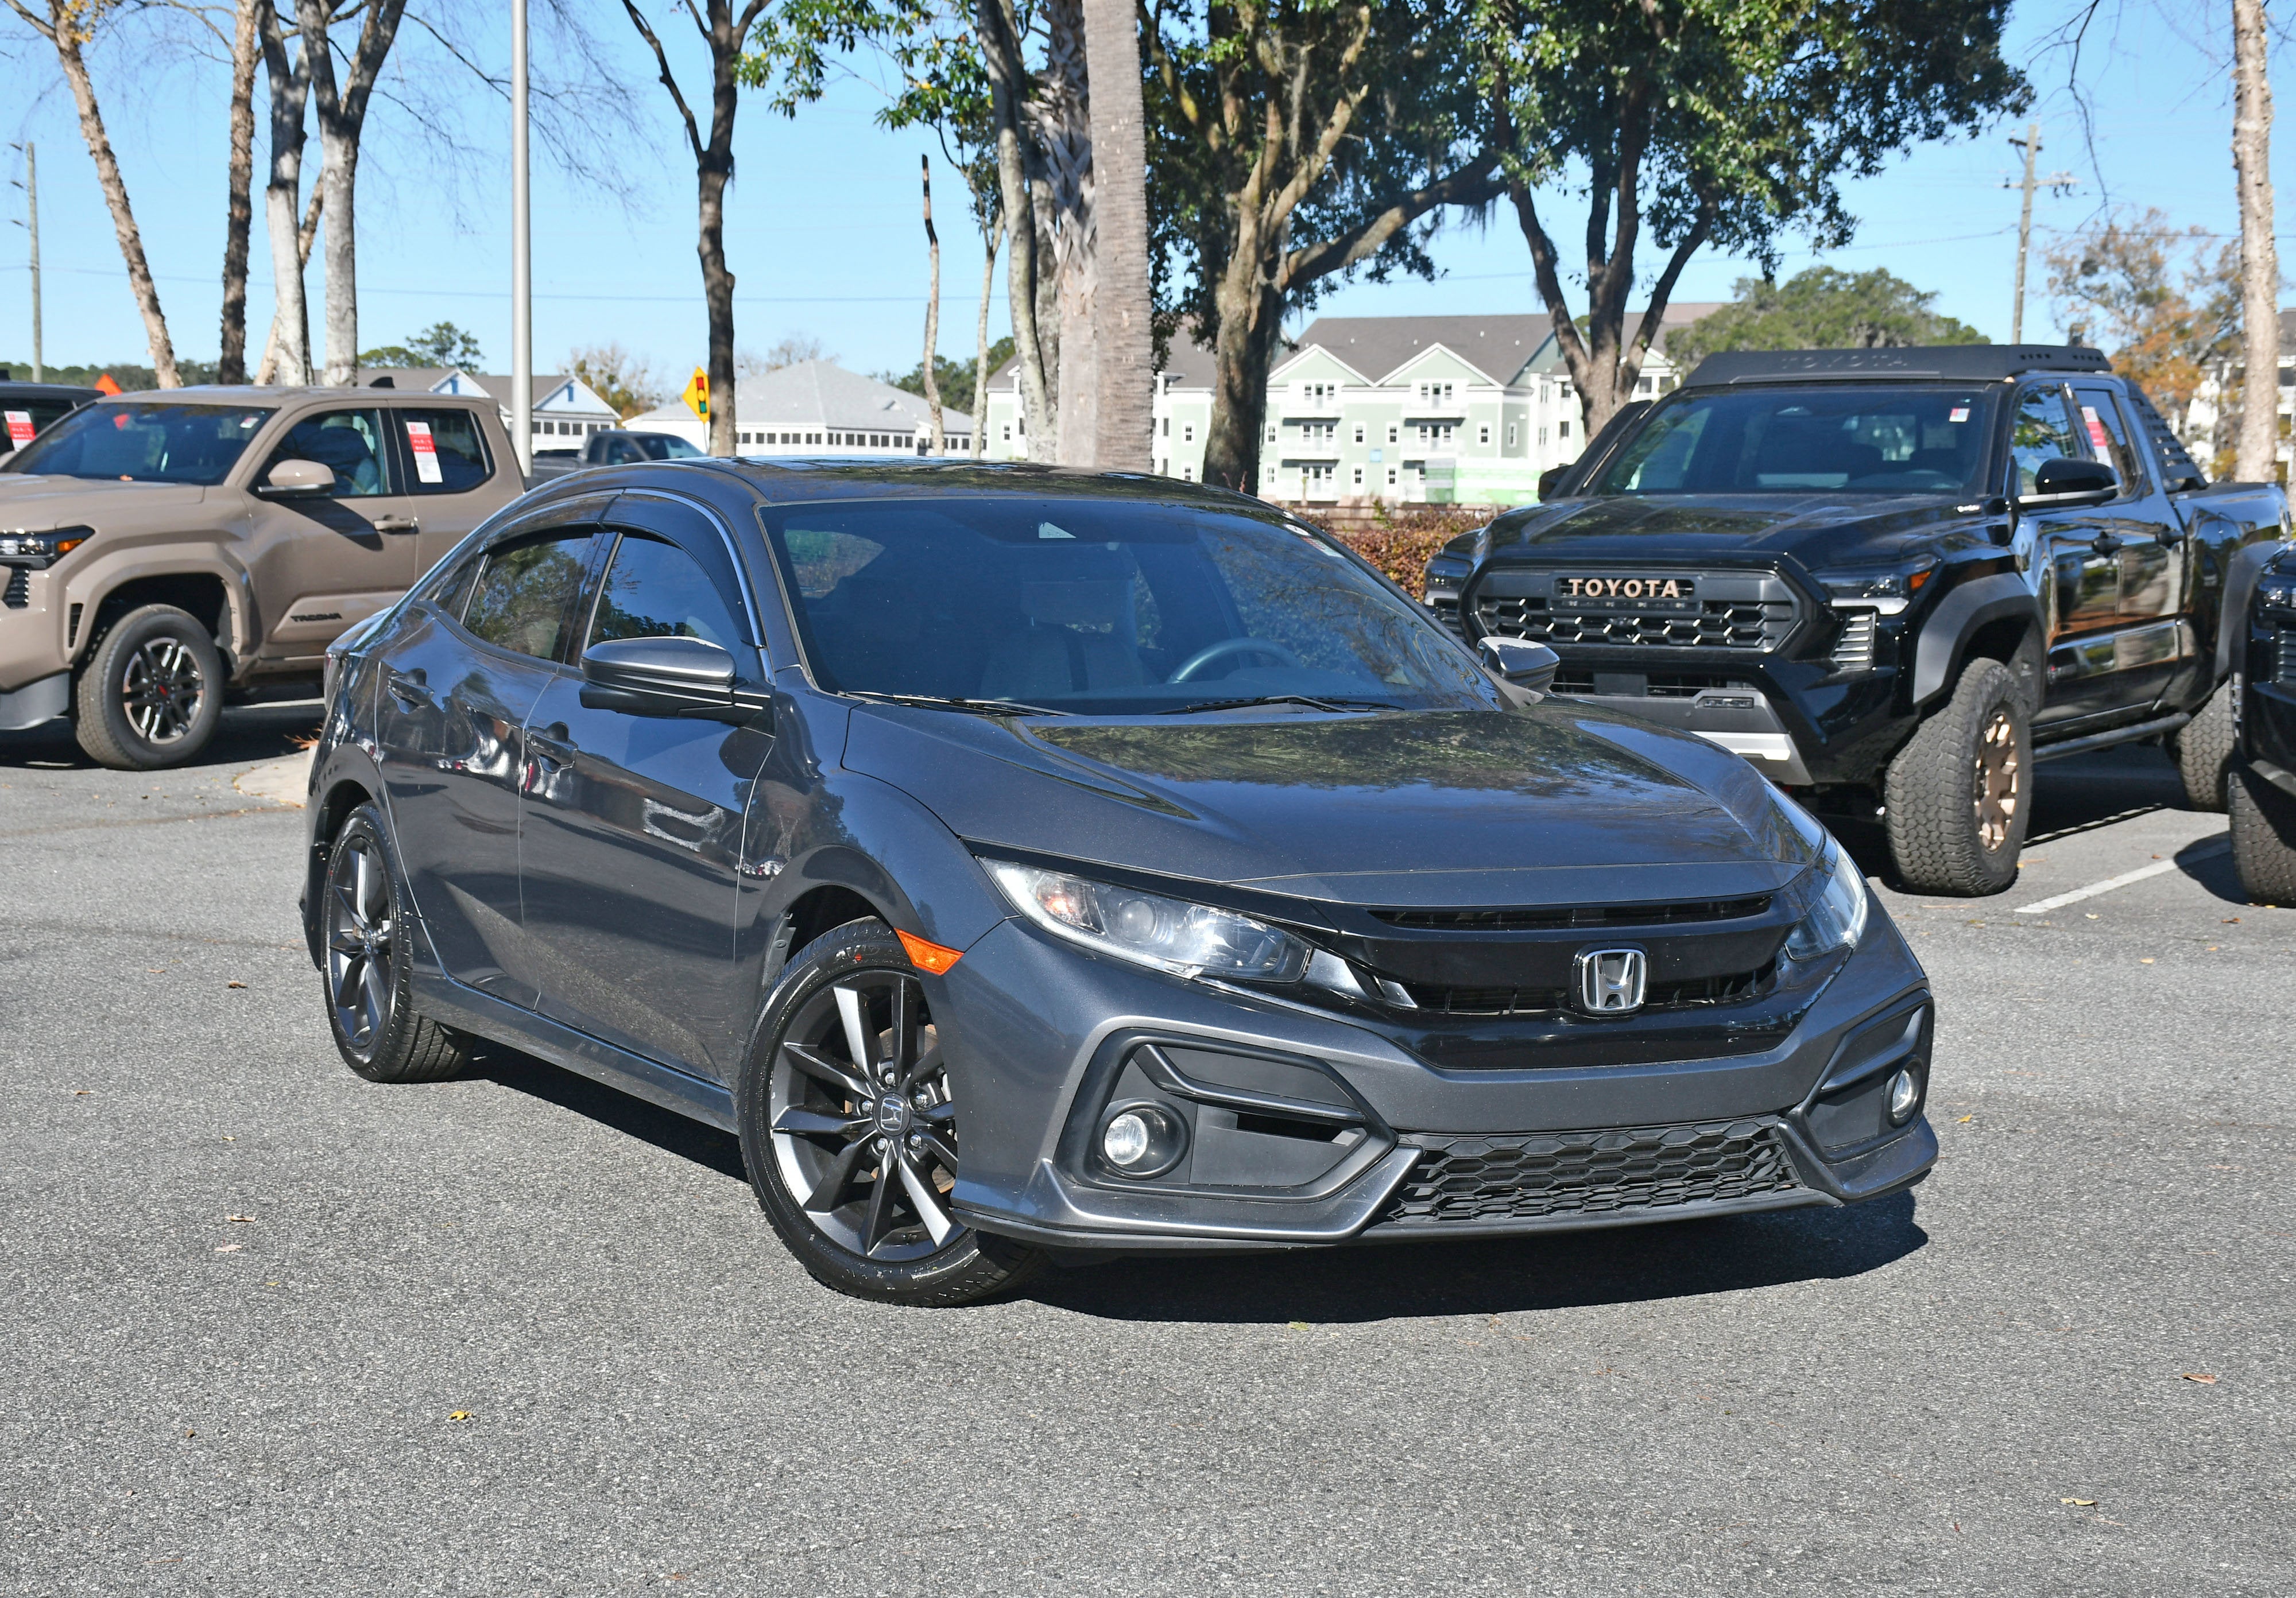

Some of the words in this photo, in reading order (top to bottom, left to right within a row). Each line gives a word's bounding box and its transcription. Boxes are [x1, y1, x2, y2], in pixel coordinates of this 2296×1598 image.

[1782, 355, 1908, 369] TOYOTA
[1568, 579, 1679, 598] TOYOTA
[290, 612, 343, 622] TACOMA
